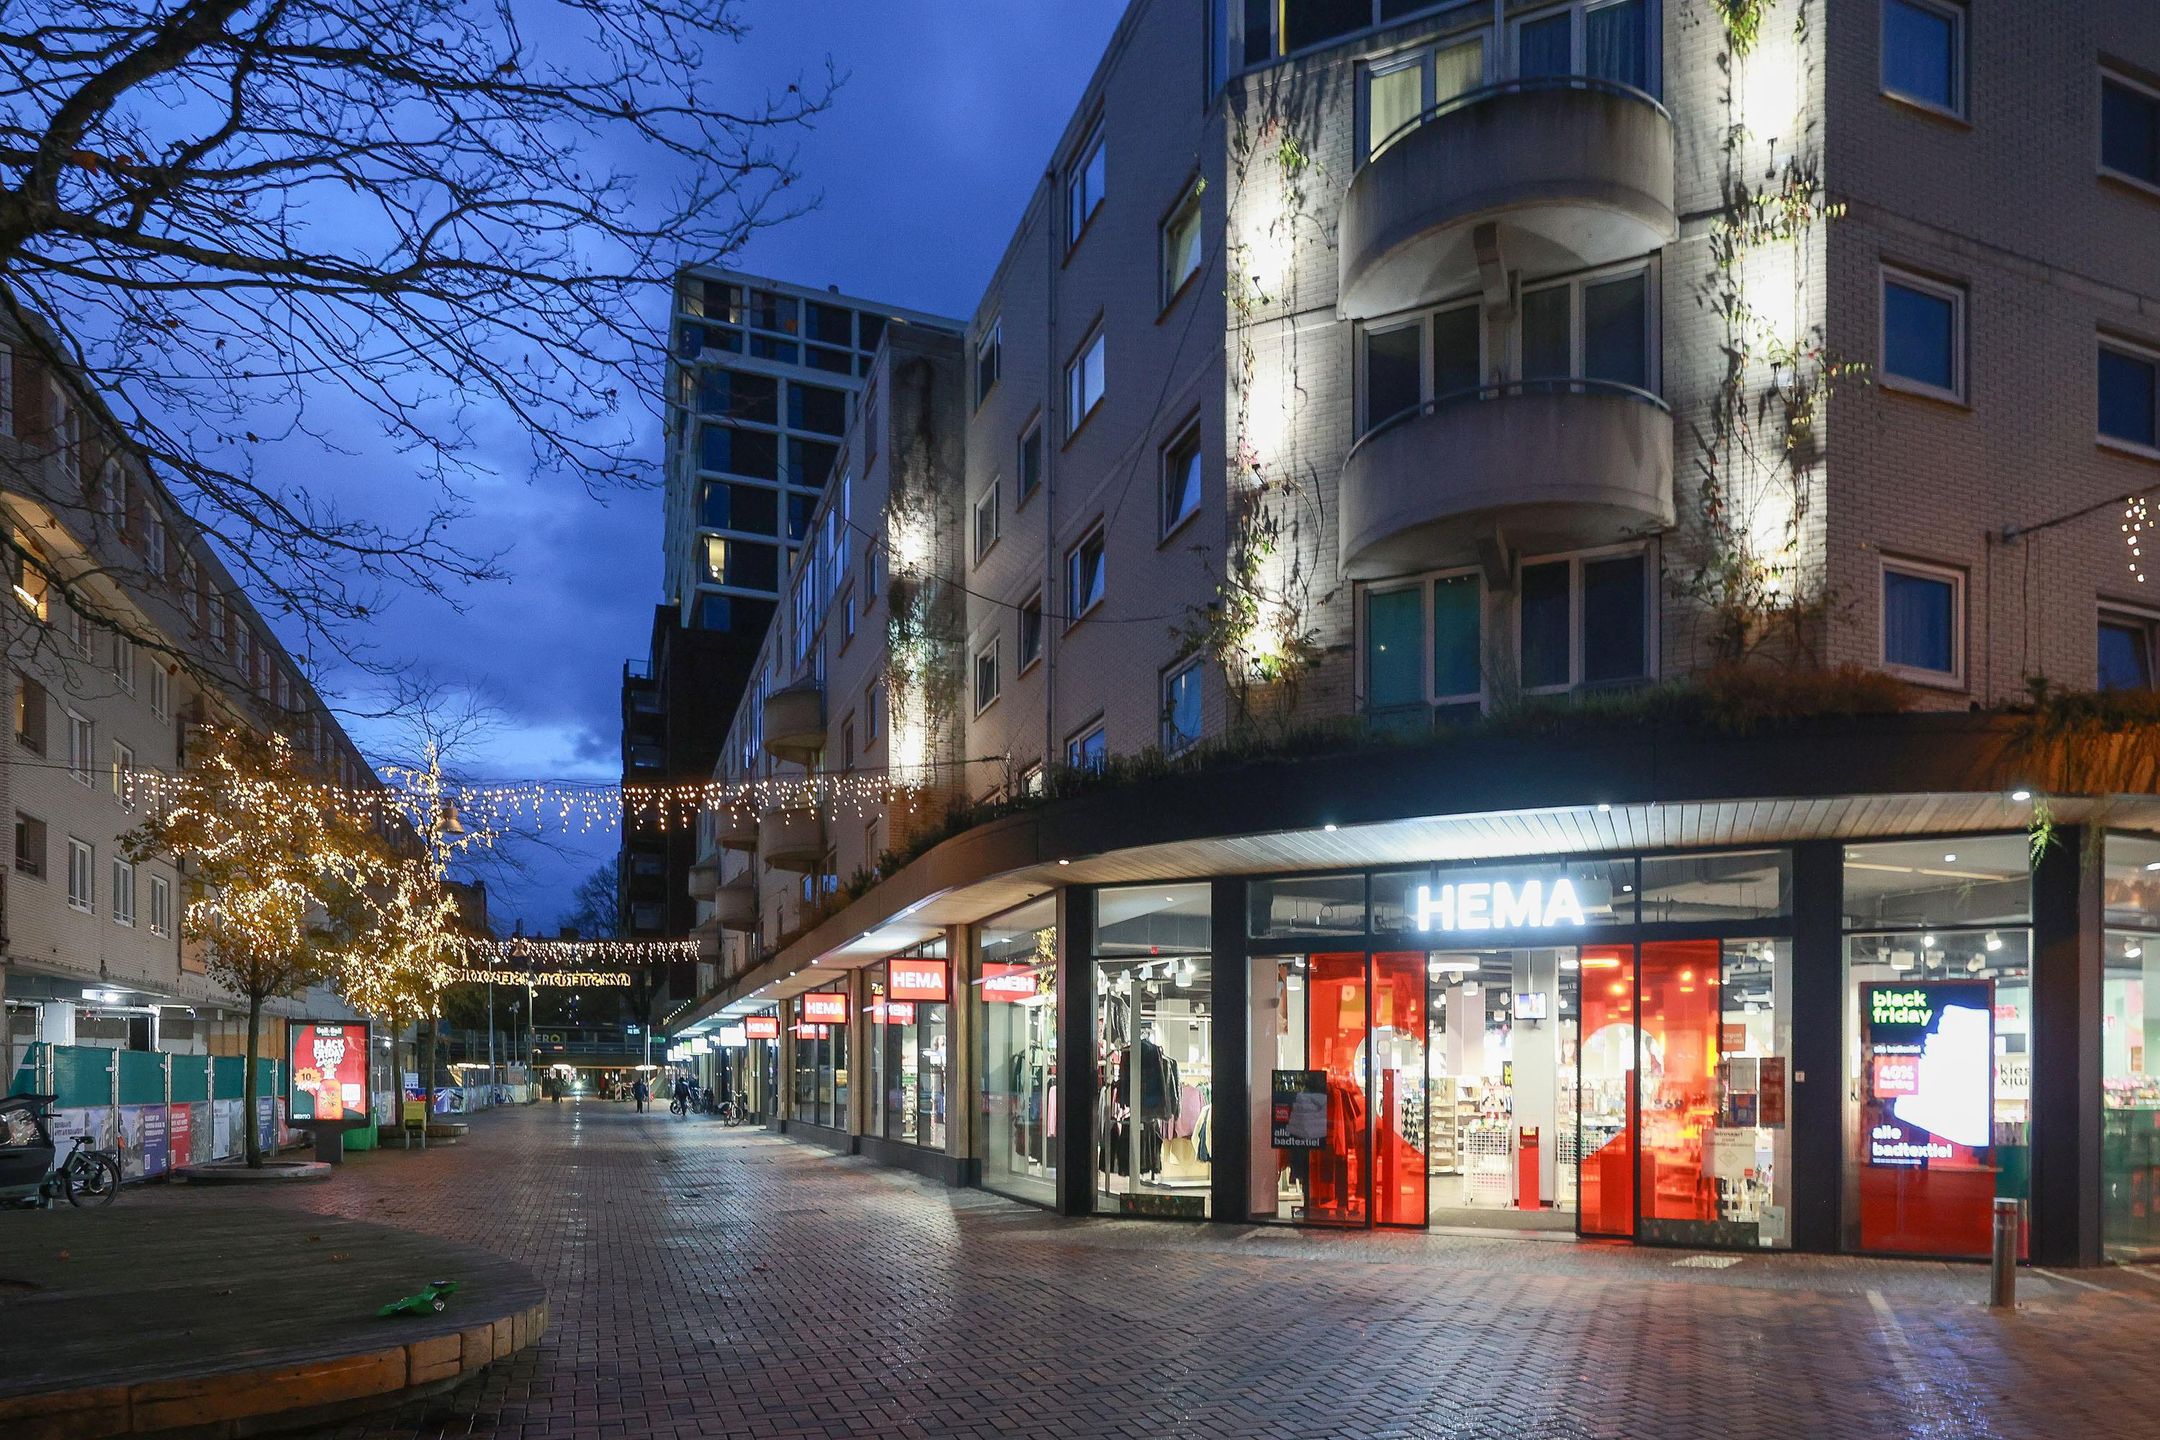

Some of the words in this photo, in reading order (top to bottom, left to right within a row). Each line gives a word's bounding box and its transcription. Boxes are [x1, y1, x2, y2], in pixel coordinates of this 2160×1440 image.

[1418, 879, 1586, 931] HEMA
[892, 972, 943, 989] HEMA
[1873, 990, 1927, 1007] black
[806, 1002, 843, 1015] HEMA
[1873, 1006, 1933, 1026] friday
[313, 1039, 345, 1049] BLACK
[1880, 1065, 1914, 1080] 40%
[2000, 1062, 2030, 1076] kies
[1274, 1128, 1290, 1137] alle
[1872, 1125, 1902, 1139] alle
[1274, 1137, 1320, 1147] badtextiel
[1872, 1141, 1953, 1158] badtextiel
